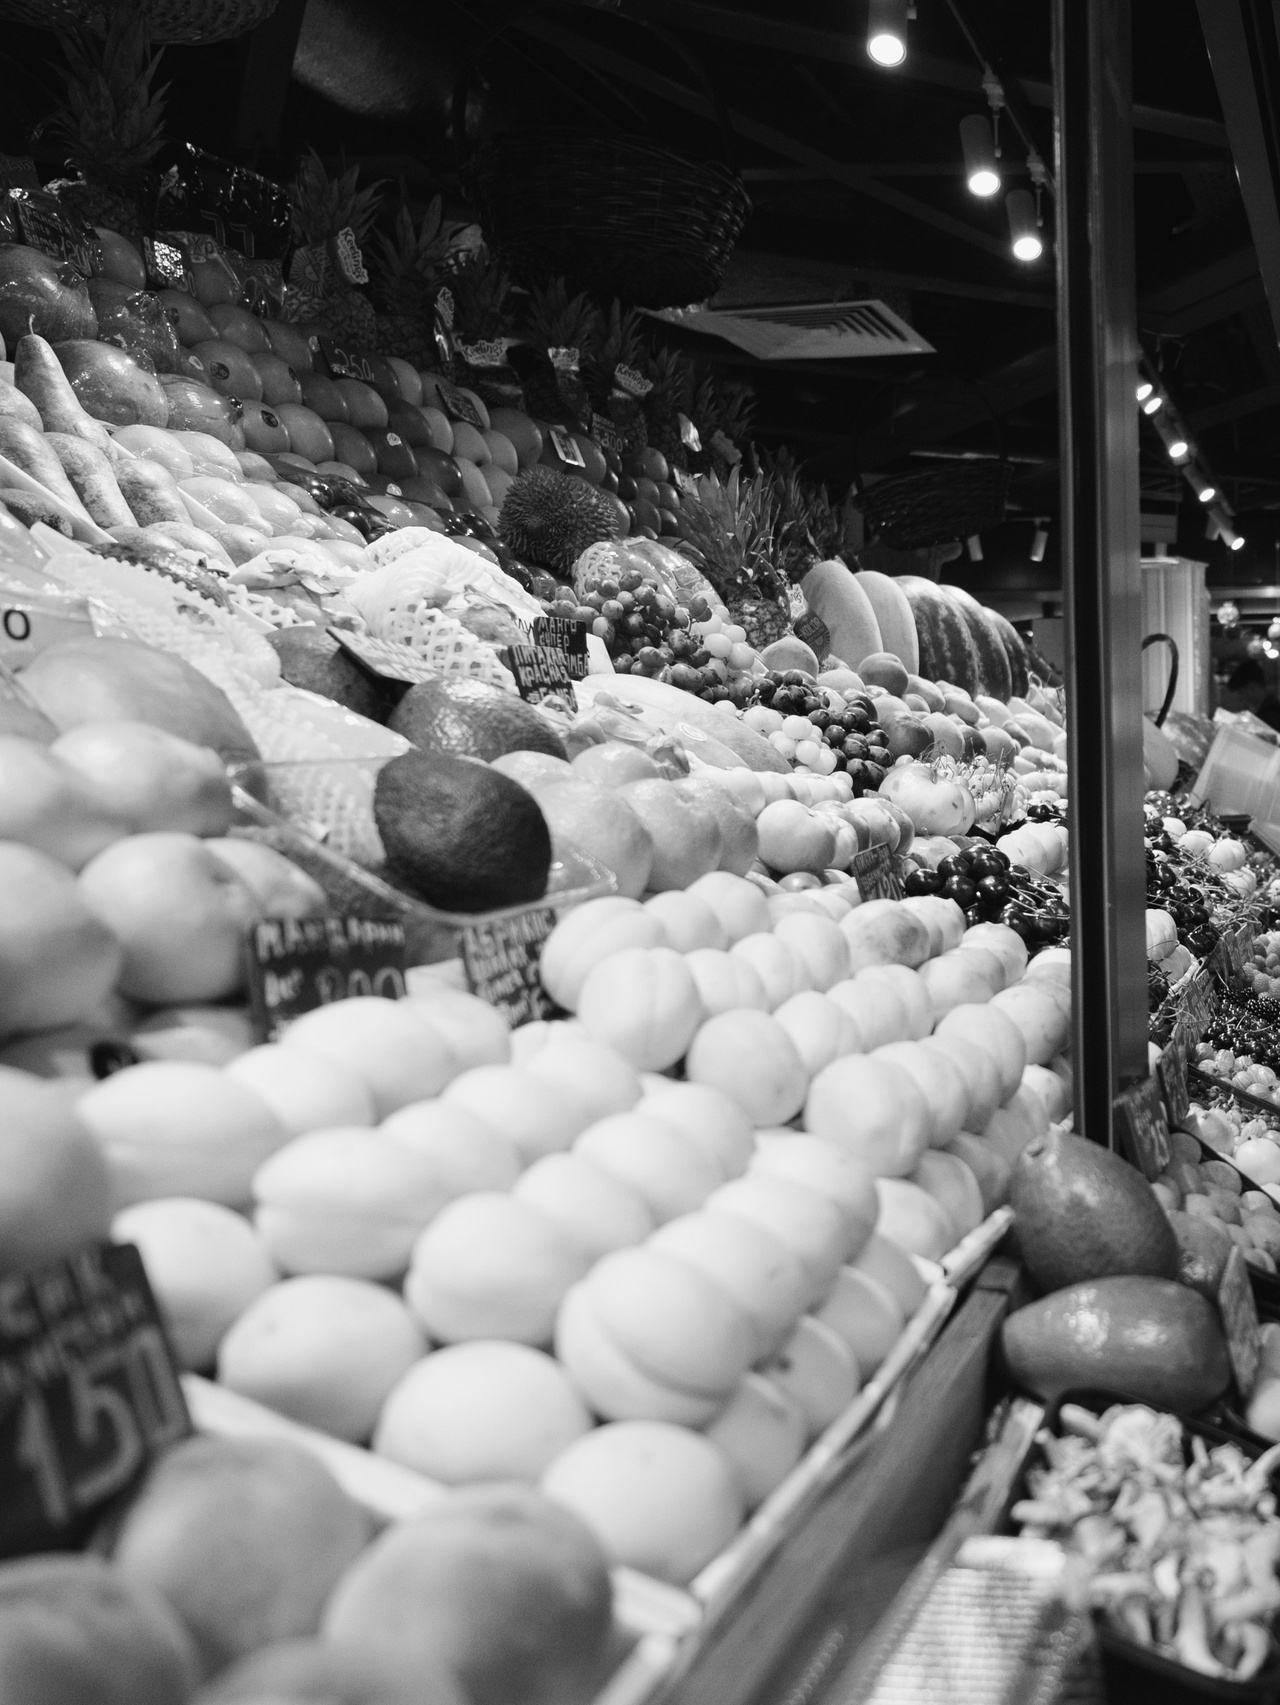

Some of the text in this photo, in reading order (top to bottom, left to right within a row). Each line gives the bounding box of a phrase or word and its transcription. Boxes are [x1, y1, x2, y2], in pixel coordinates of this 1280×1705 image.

[341, 228, 364, 280] Keelings
[538, 617, 578, 633] МАНГО
[539, 631, 570, 653] СУПЕР
[518, 661, 571, 687] КРАСНАЯ
